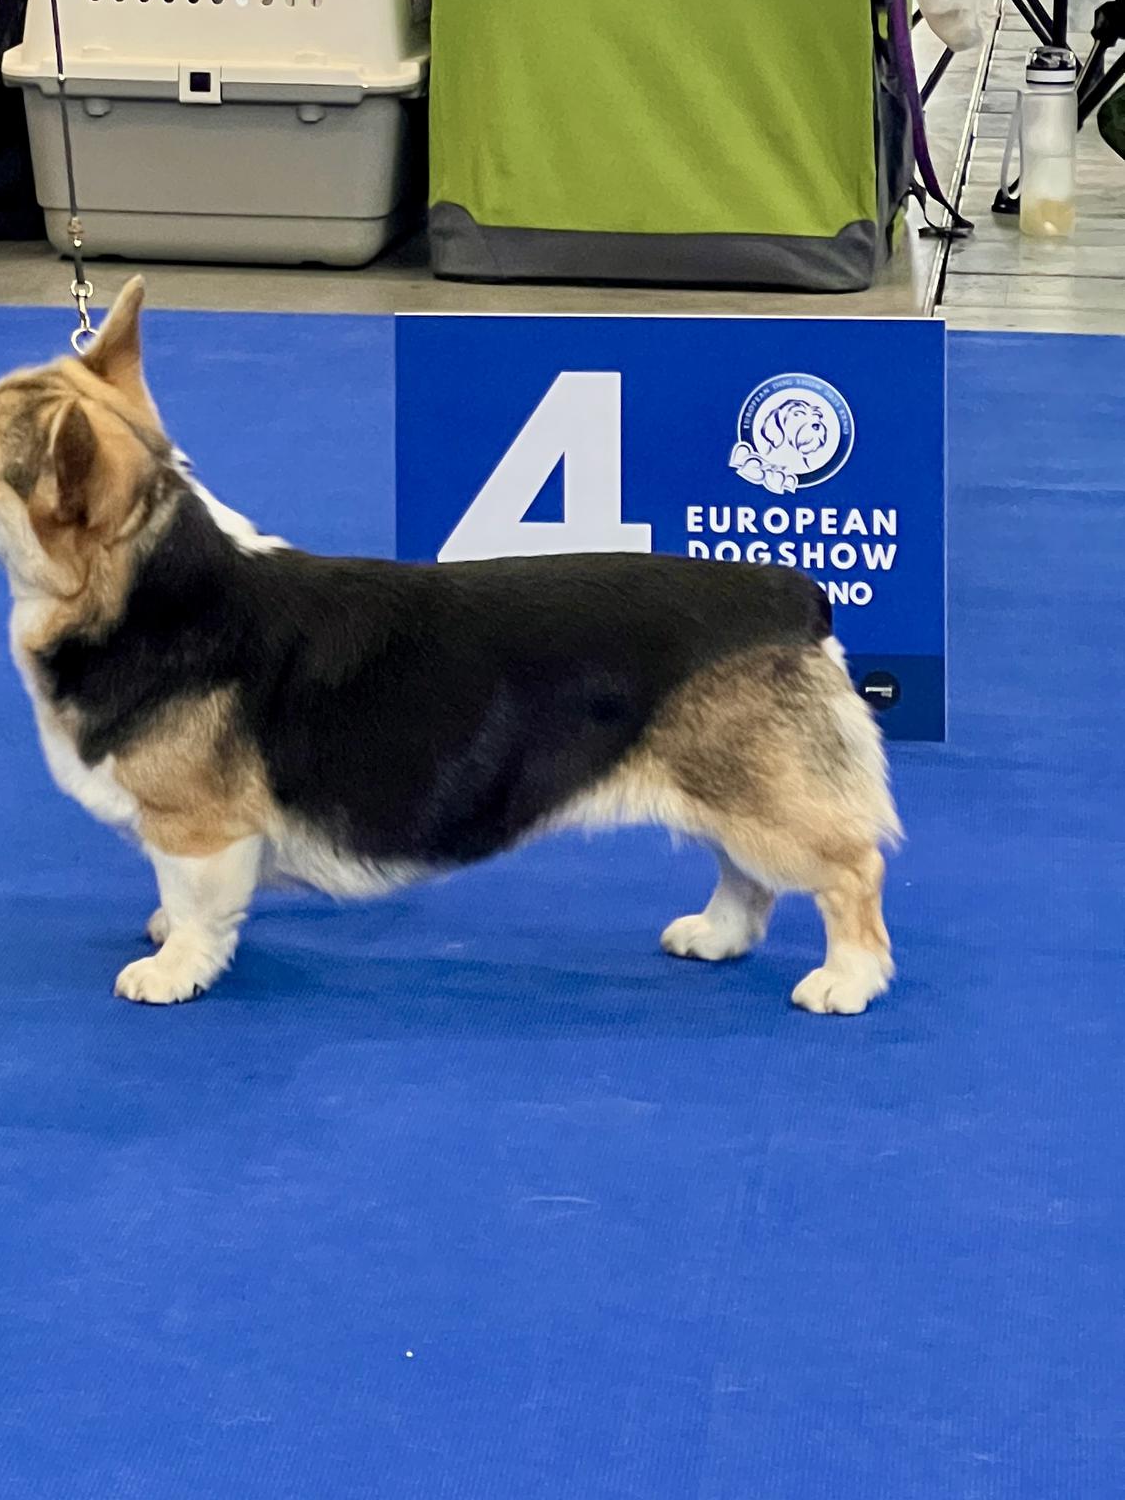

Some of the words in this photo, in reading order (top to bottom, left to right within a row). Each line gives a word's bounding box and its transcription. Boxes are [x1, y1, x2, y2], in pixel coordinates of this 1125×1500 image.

[437, 371, 652, 563] 4
[686, 505, 897, 536] EUROPEAN
[687, 540, 897, 570] DOGSHOW
